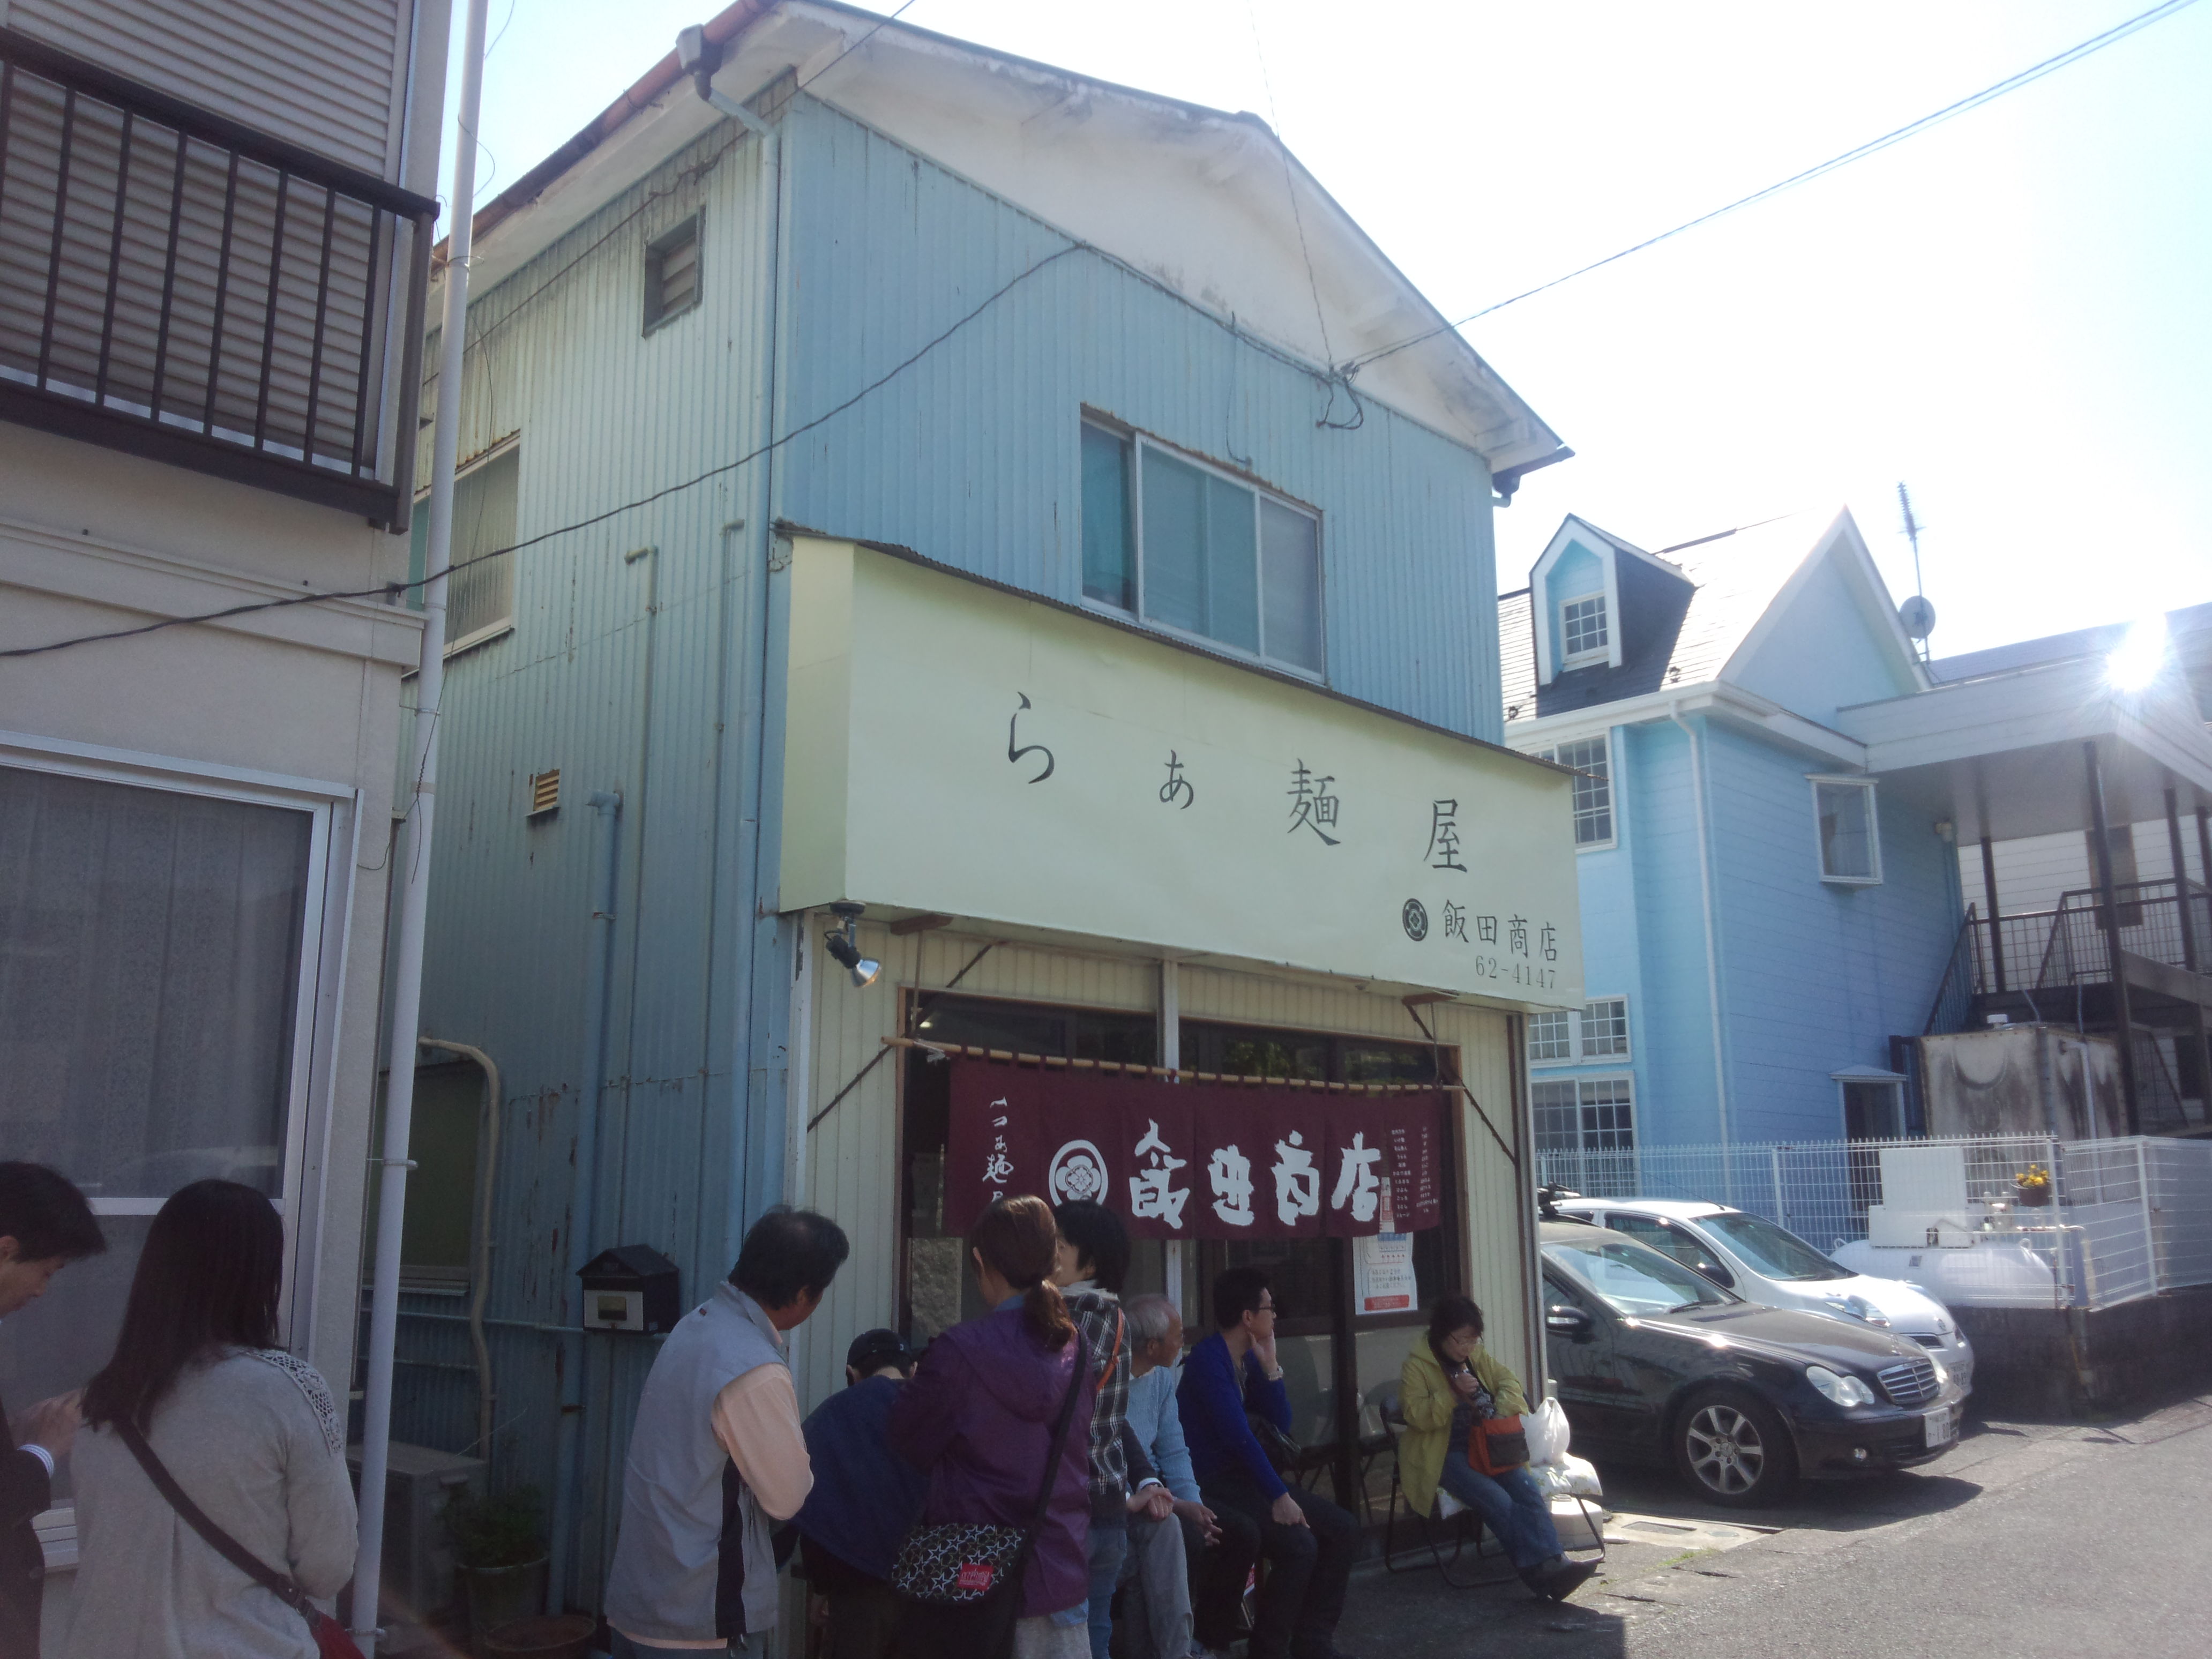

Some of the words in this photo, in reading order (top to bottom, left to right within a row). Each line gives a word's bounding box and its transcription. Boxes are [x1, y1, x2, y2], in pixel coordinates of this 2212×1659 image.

[1008, 691, 1468, 872] らぁ麺屋
[1442, 899, 1557, 961] 飯田商店
[1475, 955, 1556, 989] 62-4147
[1129, 1117, 1381, 1229] 飯田商店
